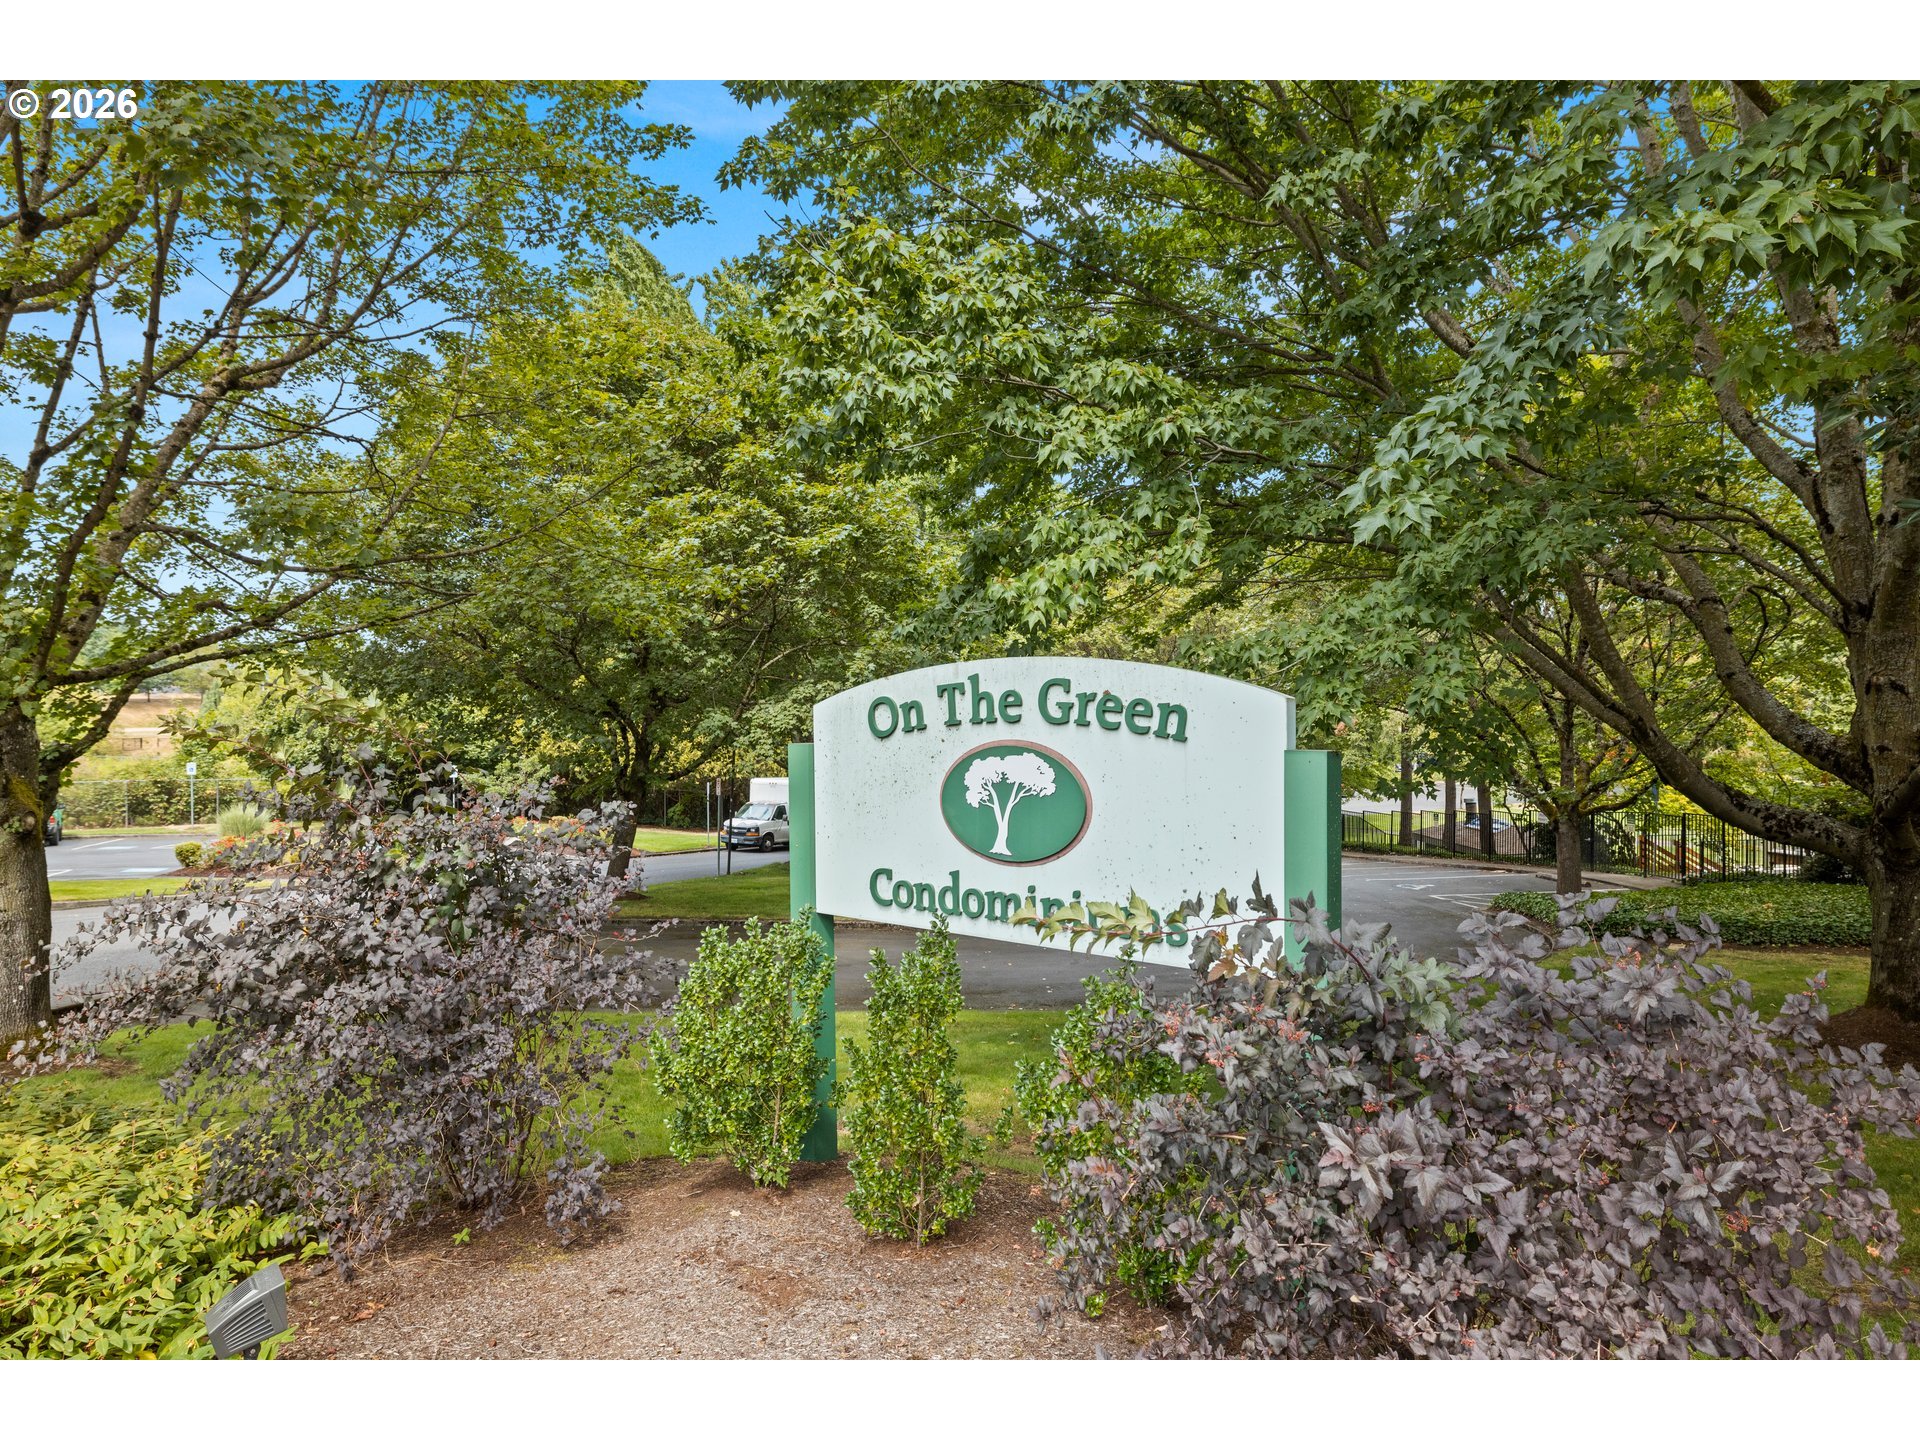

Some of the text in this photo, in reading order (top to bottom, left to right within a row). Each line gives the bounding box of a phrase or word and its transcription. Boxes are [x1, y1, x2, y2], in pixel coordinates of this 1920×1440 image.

[868, 673, 1188, 742] On The Green
